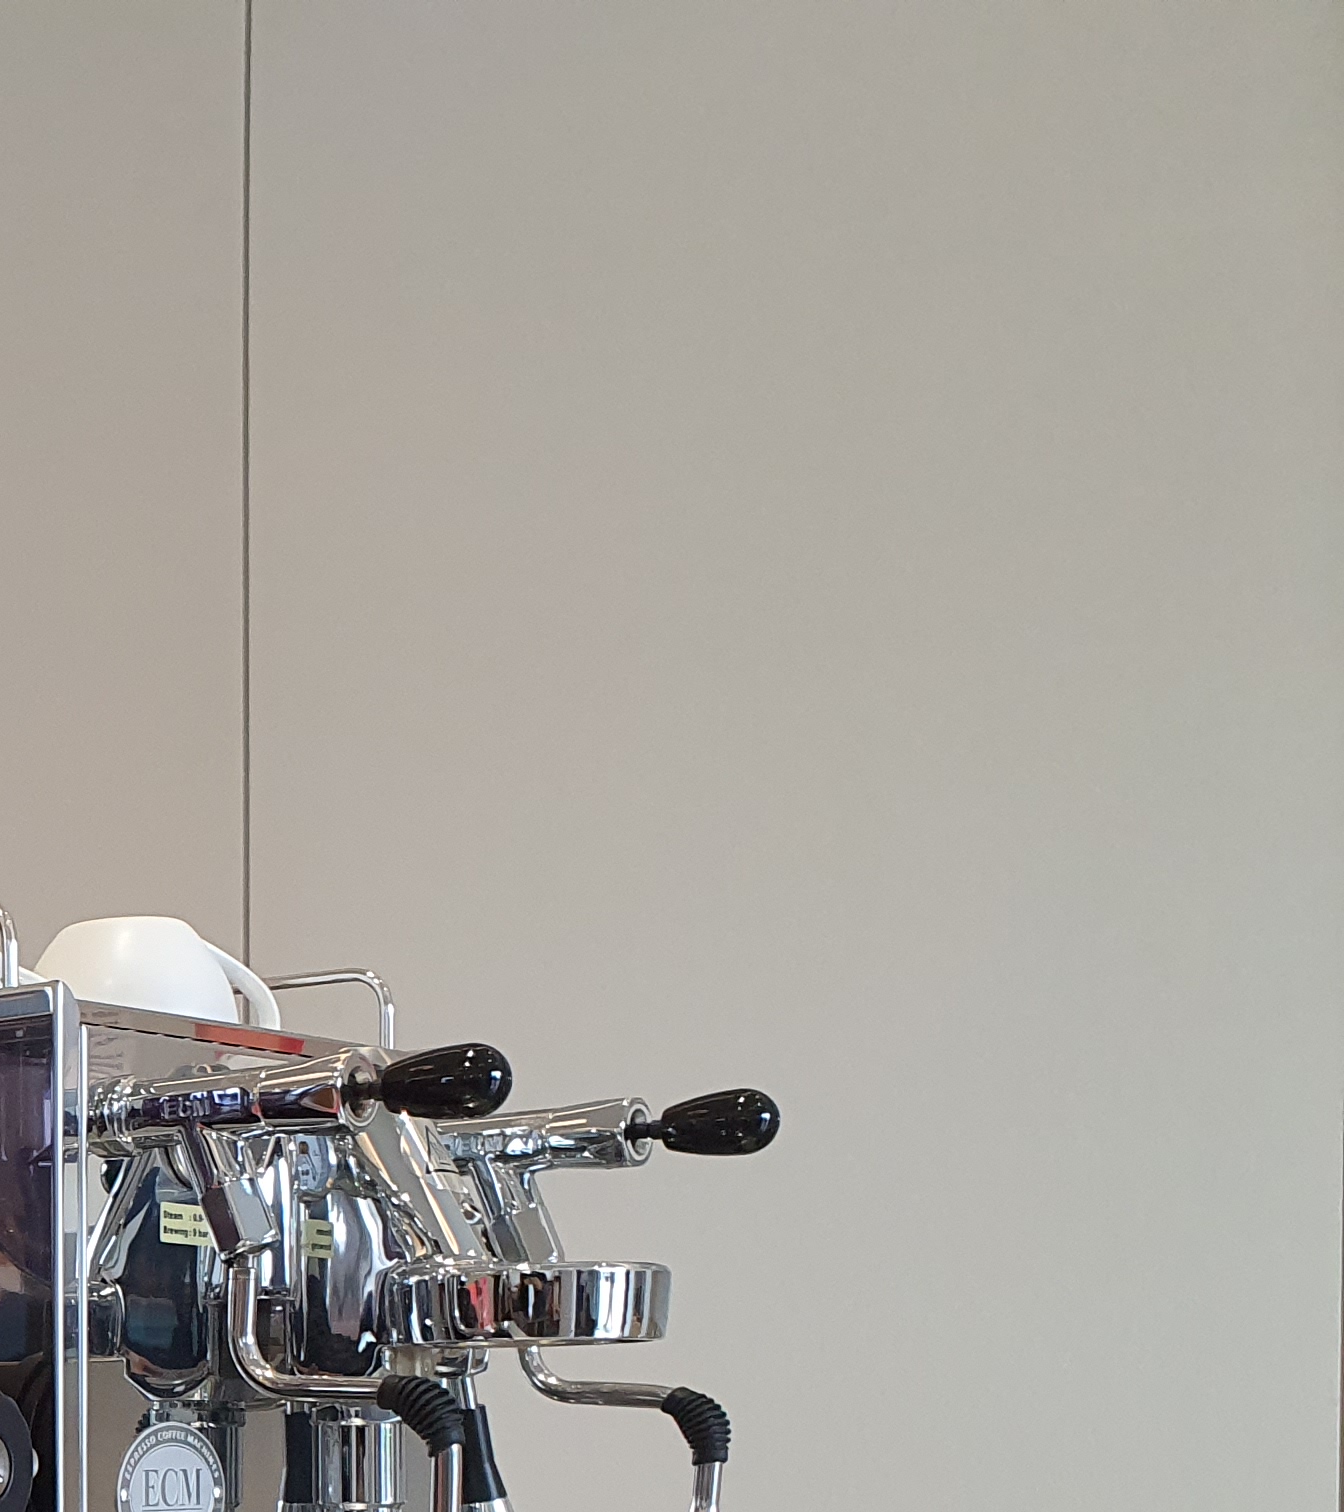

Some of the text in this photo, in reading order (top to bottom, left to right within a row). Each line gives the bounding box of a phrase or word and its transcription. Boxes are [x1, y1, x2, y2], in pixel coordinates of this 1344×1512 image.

[157, 1430, 187, 1442] COFFEE
[187, 1433, 220, 1478] MACHINES
[142, 1468, 203, 1508] ECM
